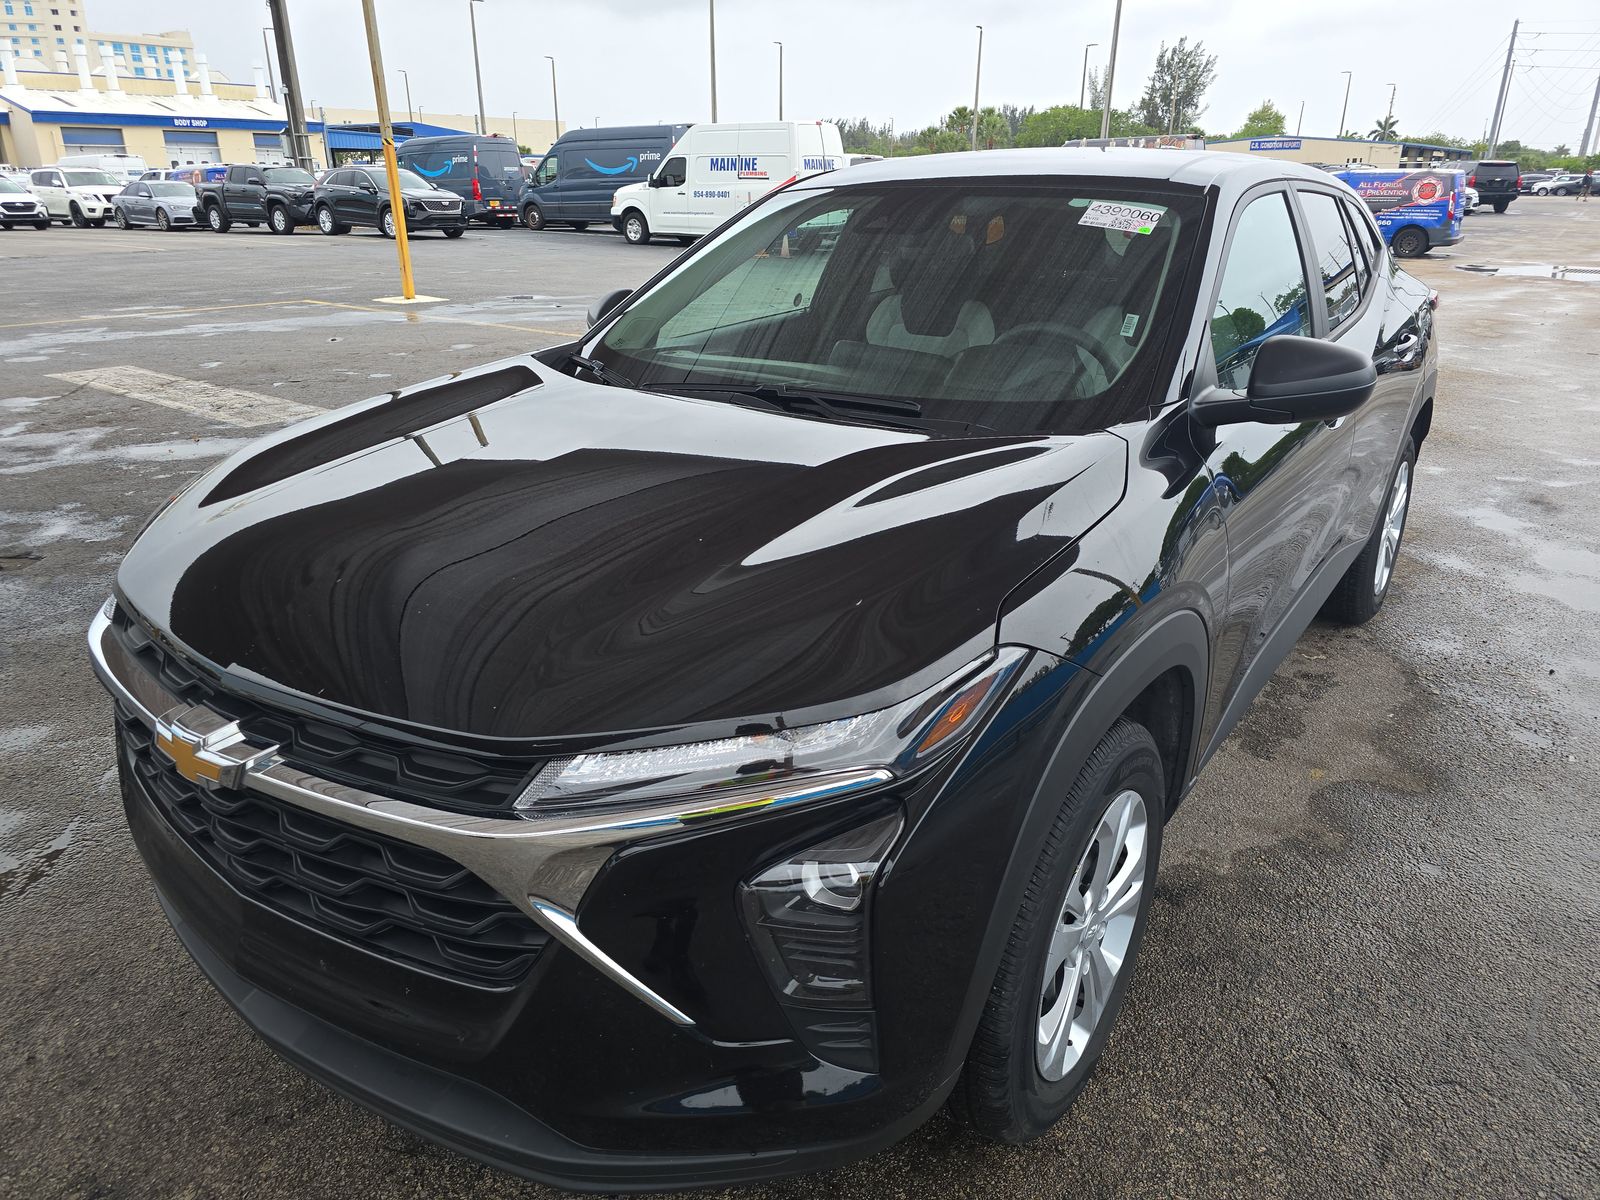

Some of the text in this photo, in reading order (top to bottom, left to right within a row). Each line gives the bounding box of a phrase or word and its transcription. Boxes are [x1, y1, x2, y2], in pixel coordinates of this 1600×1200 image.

[173, 118, 208, 128] BODY SHOP
[452, 154, 469, 165] prime
[639, 150, 661, 163] prime
[1373, 181, 1403, 189] FLORIDA
[693, 190, 730, 199] 954-890-0401
[1366, 189, 1409, 197] PREVENTION
[1091, 204, 1162, 223] 4390060
